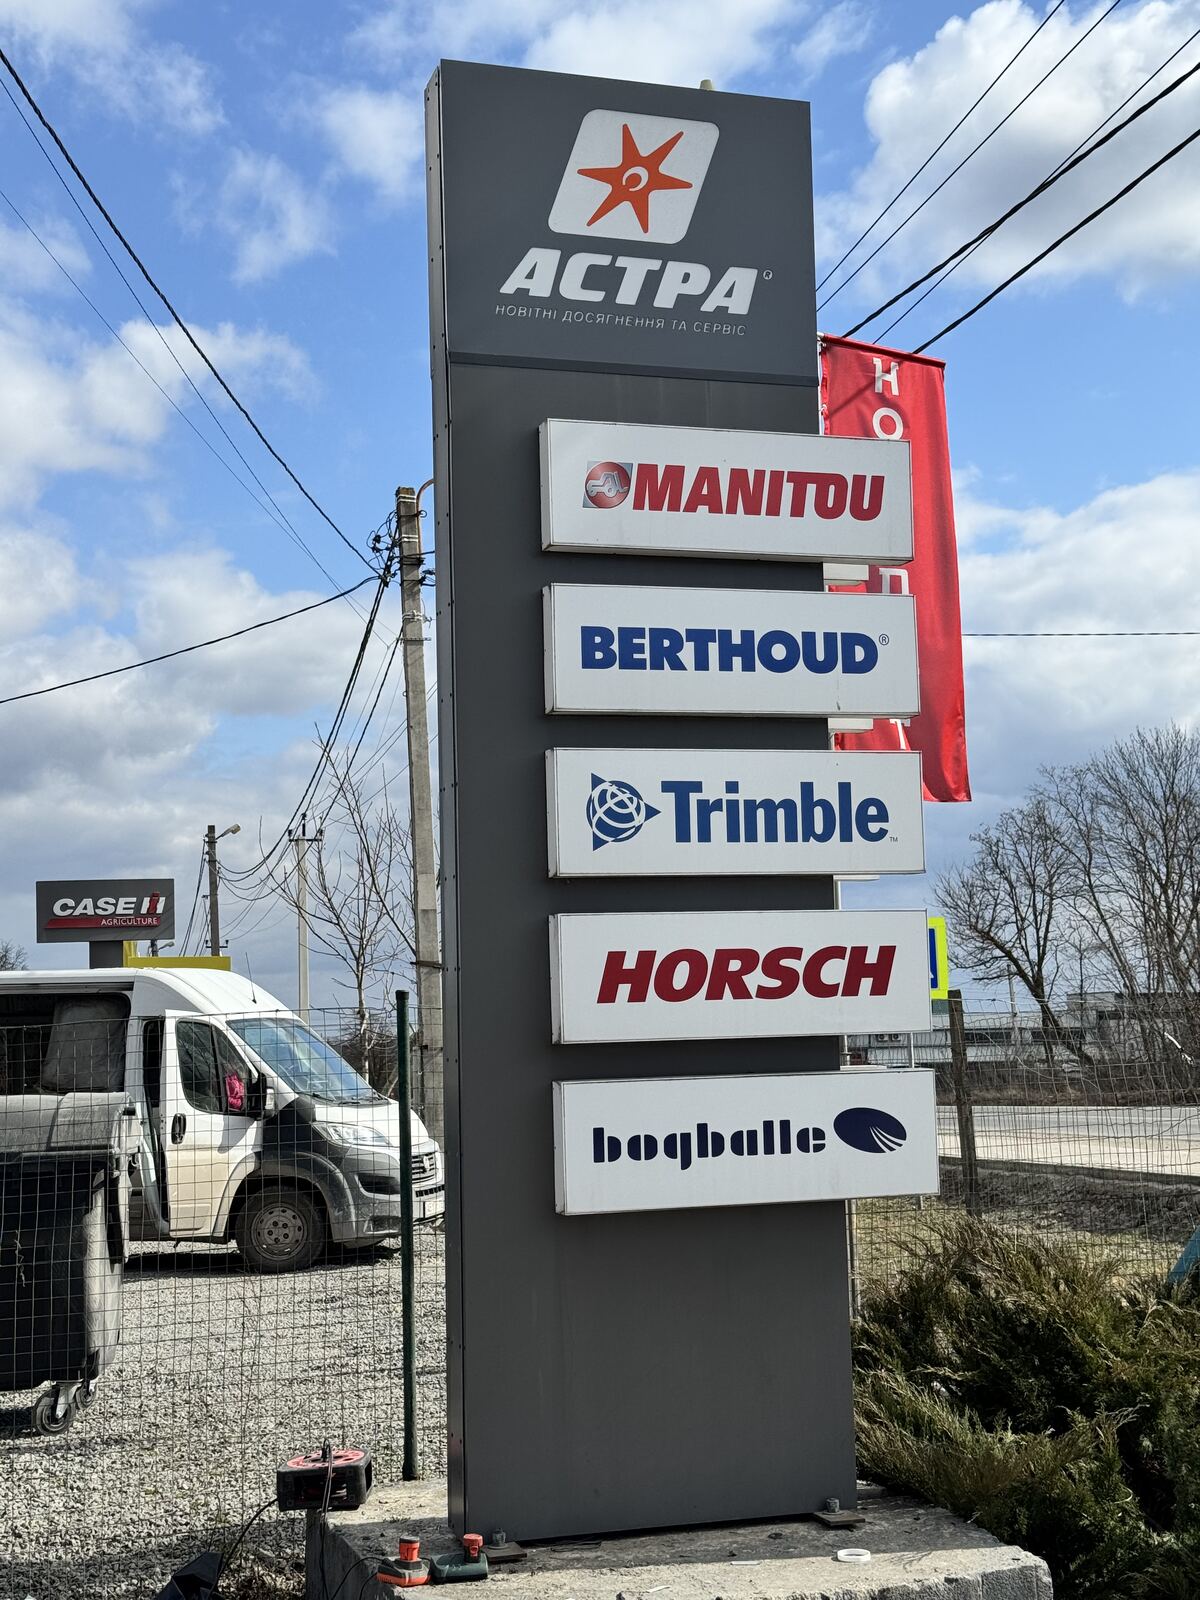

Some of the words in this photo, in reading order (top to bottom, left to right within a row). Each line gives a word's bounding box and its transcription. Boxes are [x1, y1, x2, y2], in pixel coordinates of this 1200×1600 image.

[500, 247, 758, 316] АСТРА
[495, 304, 558, 321] НОВІТНІ
[561, 310, 665, 330] ДОСЯГНЕННЯ
[671, 319, 688, 332] ТА
[693, 321, 747, 337] СЕРВІС
[632, 463, 886, 522] MANITOU
[580, 625, 879, 674] BERTHOUD
[660, 780, 890, 843] Trimble
[52, 897, 137, 917] CASE
[100, 917, 158, 927] AGRICULTURE
[596, 945, 897, 1004] HORSCH
